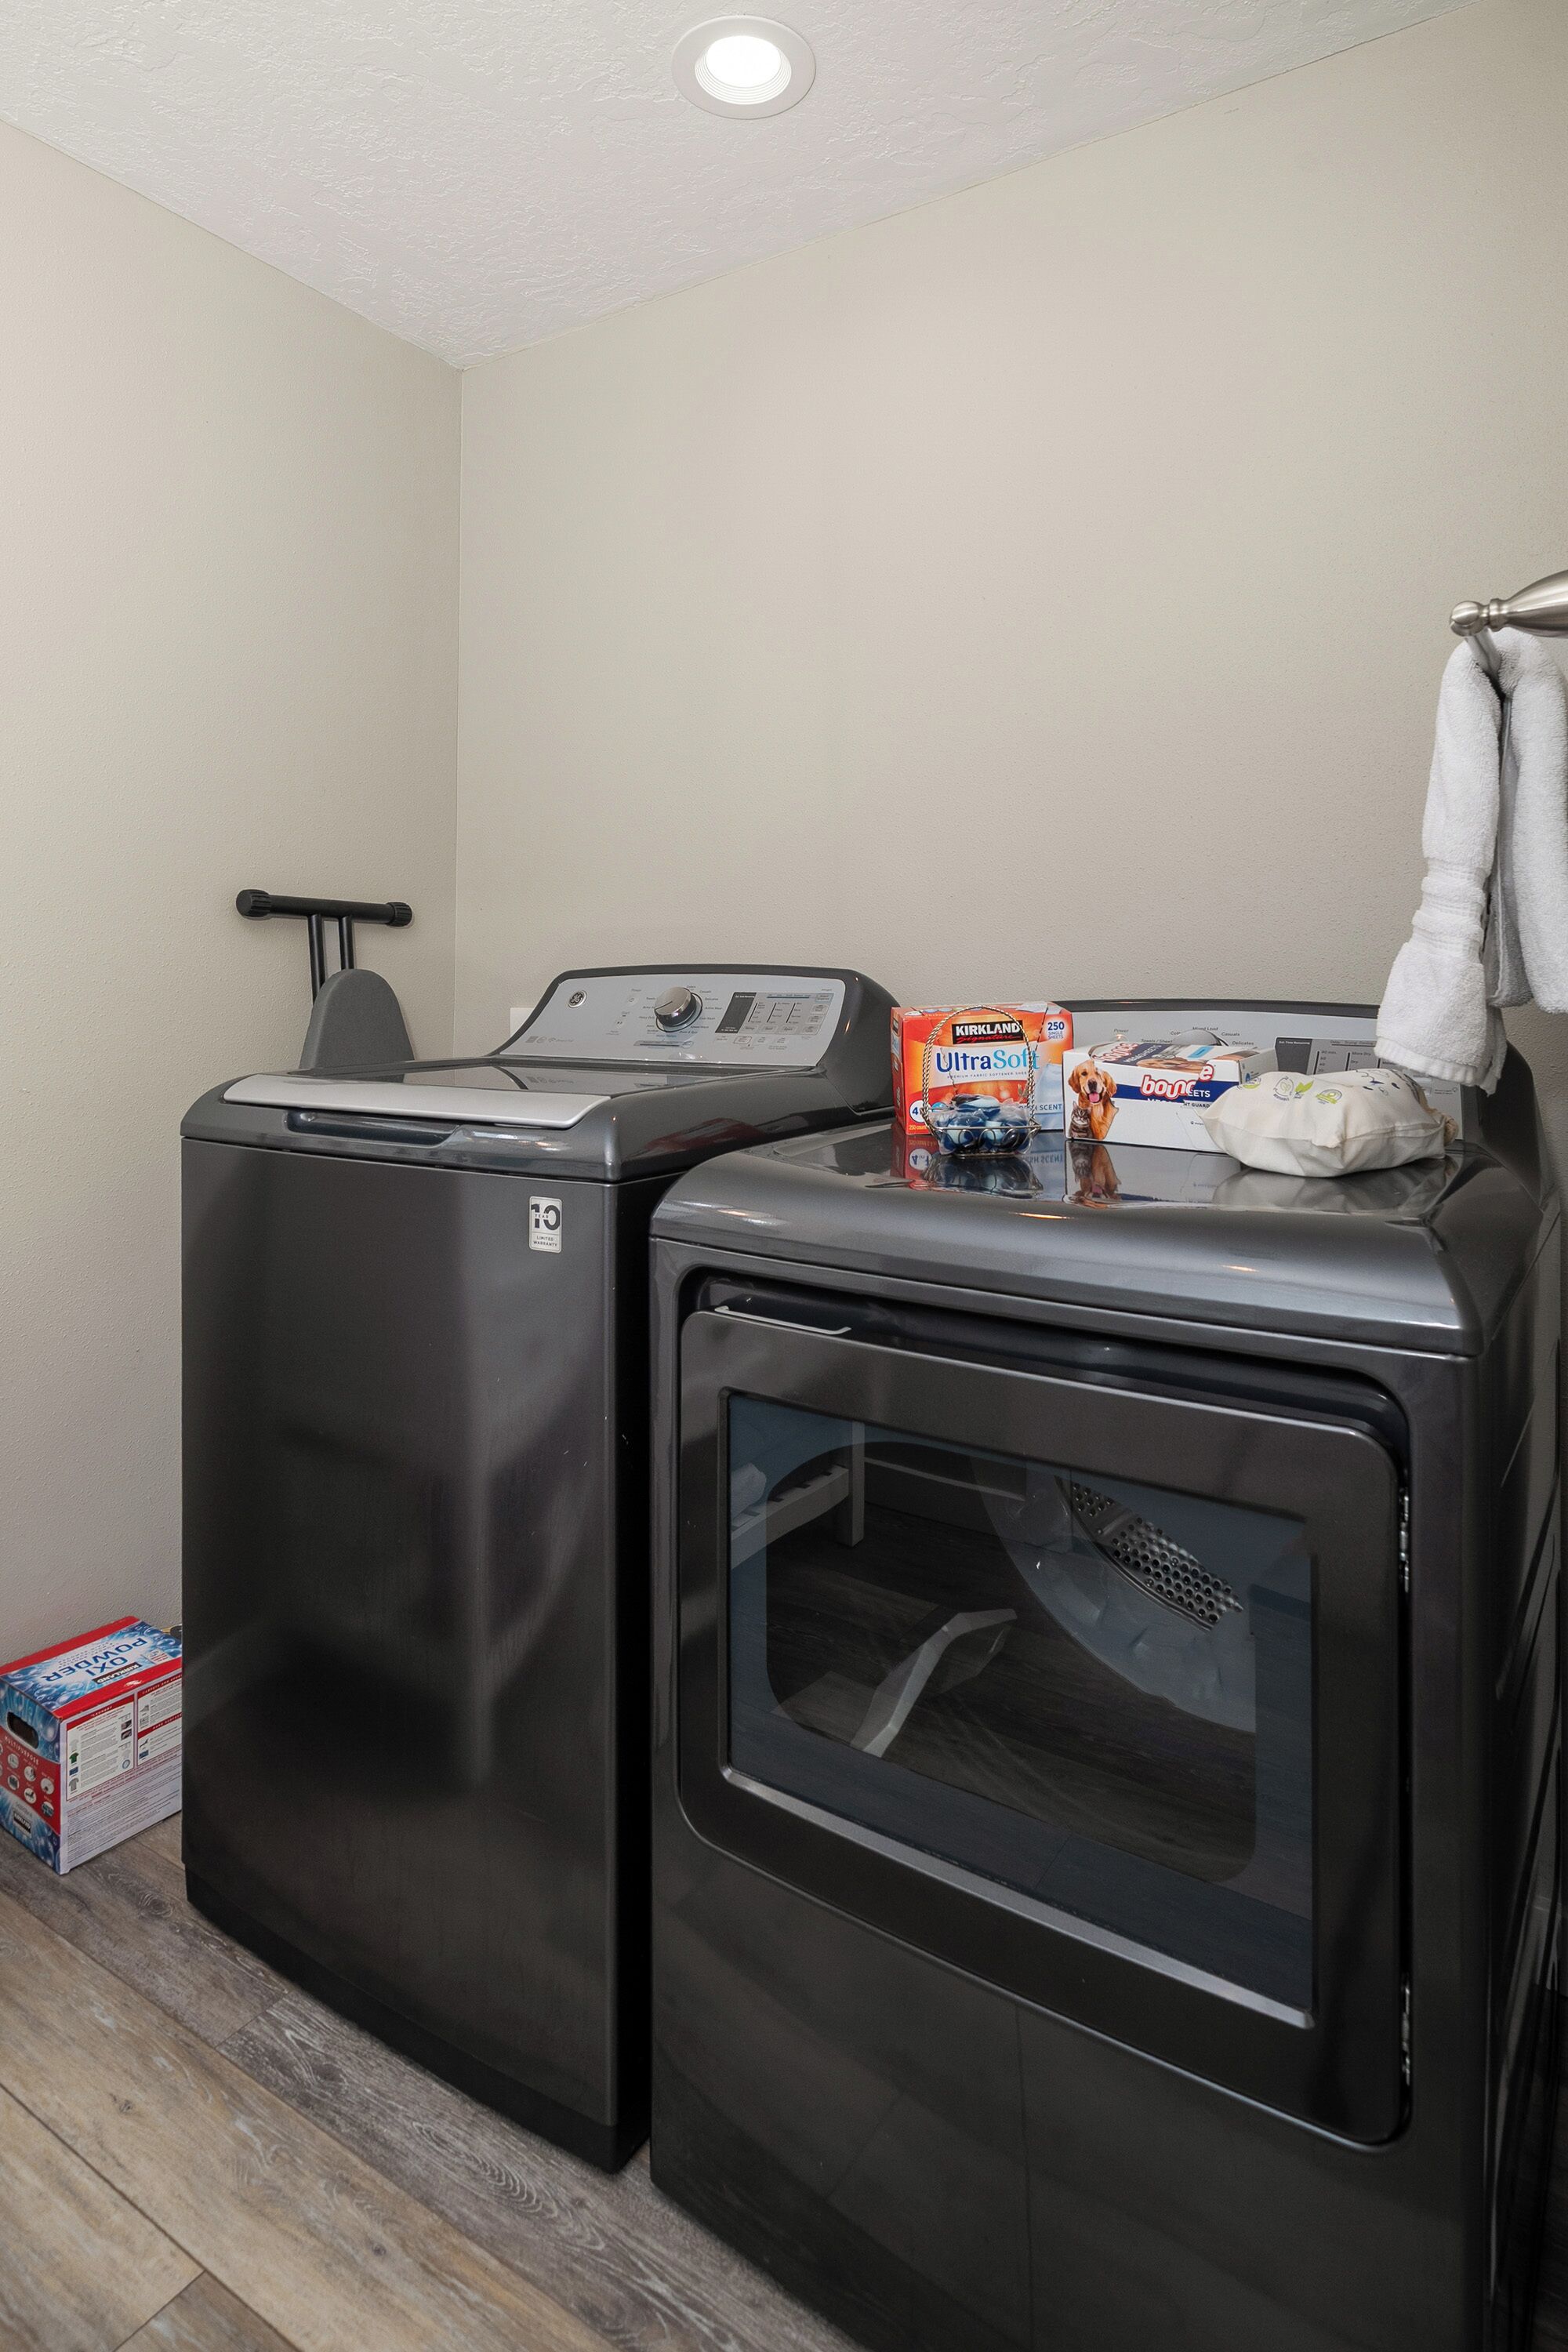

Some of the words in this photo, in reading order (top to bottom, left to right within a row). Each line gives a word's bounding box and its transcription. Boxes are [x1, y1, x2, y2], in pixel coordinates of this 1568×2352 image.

[956, 1023, 1020, 1036] KIRKLAND
[1047, 1022, 1065, 1030] 250
[956, 1034, 1019, 1044] Signature
[936, 1047, 1040, 1073] UltraSoft
[531, 1203, 561, 1231] 10
[42, 1637, 148, 1682] POWDER
[85, 1656, 129, 1676] OXI
[96, 1663, 140, 1684] KIRKLAND
[4, 1734, 39, 1766] MULTIPURPOSE
